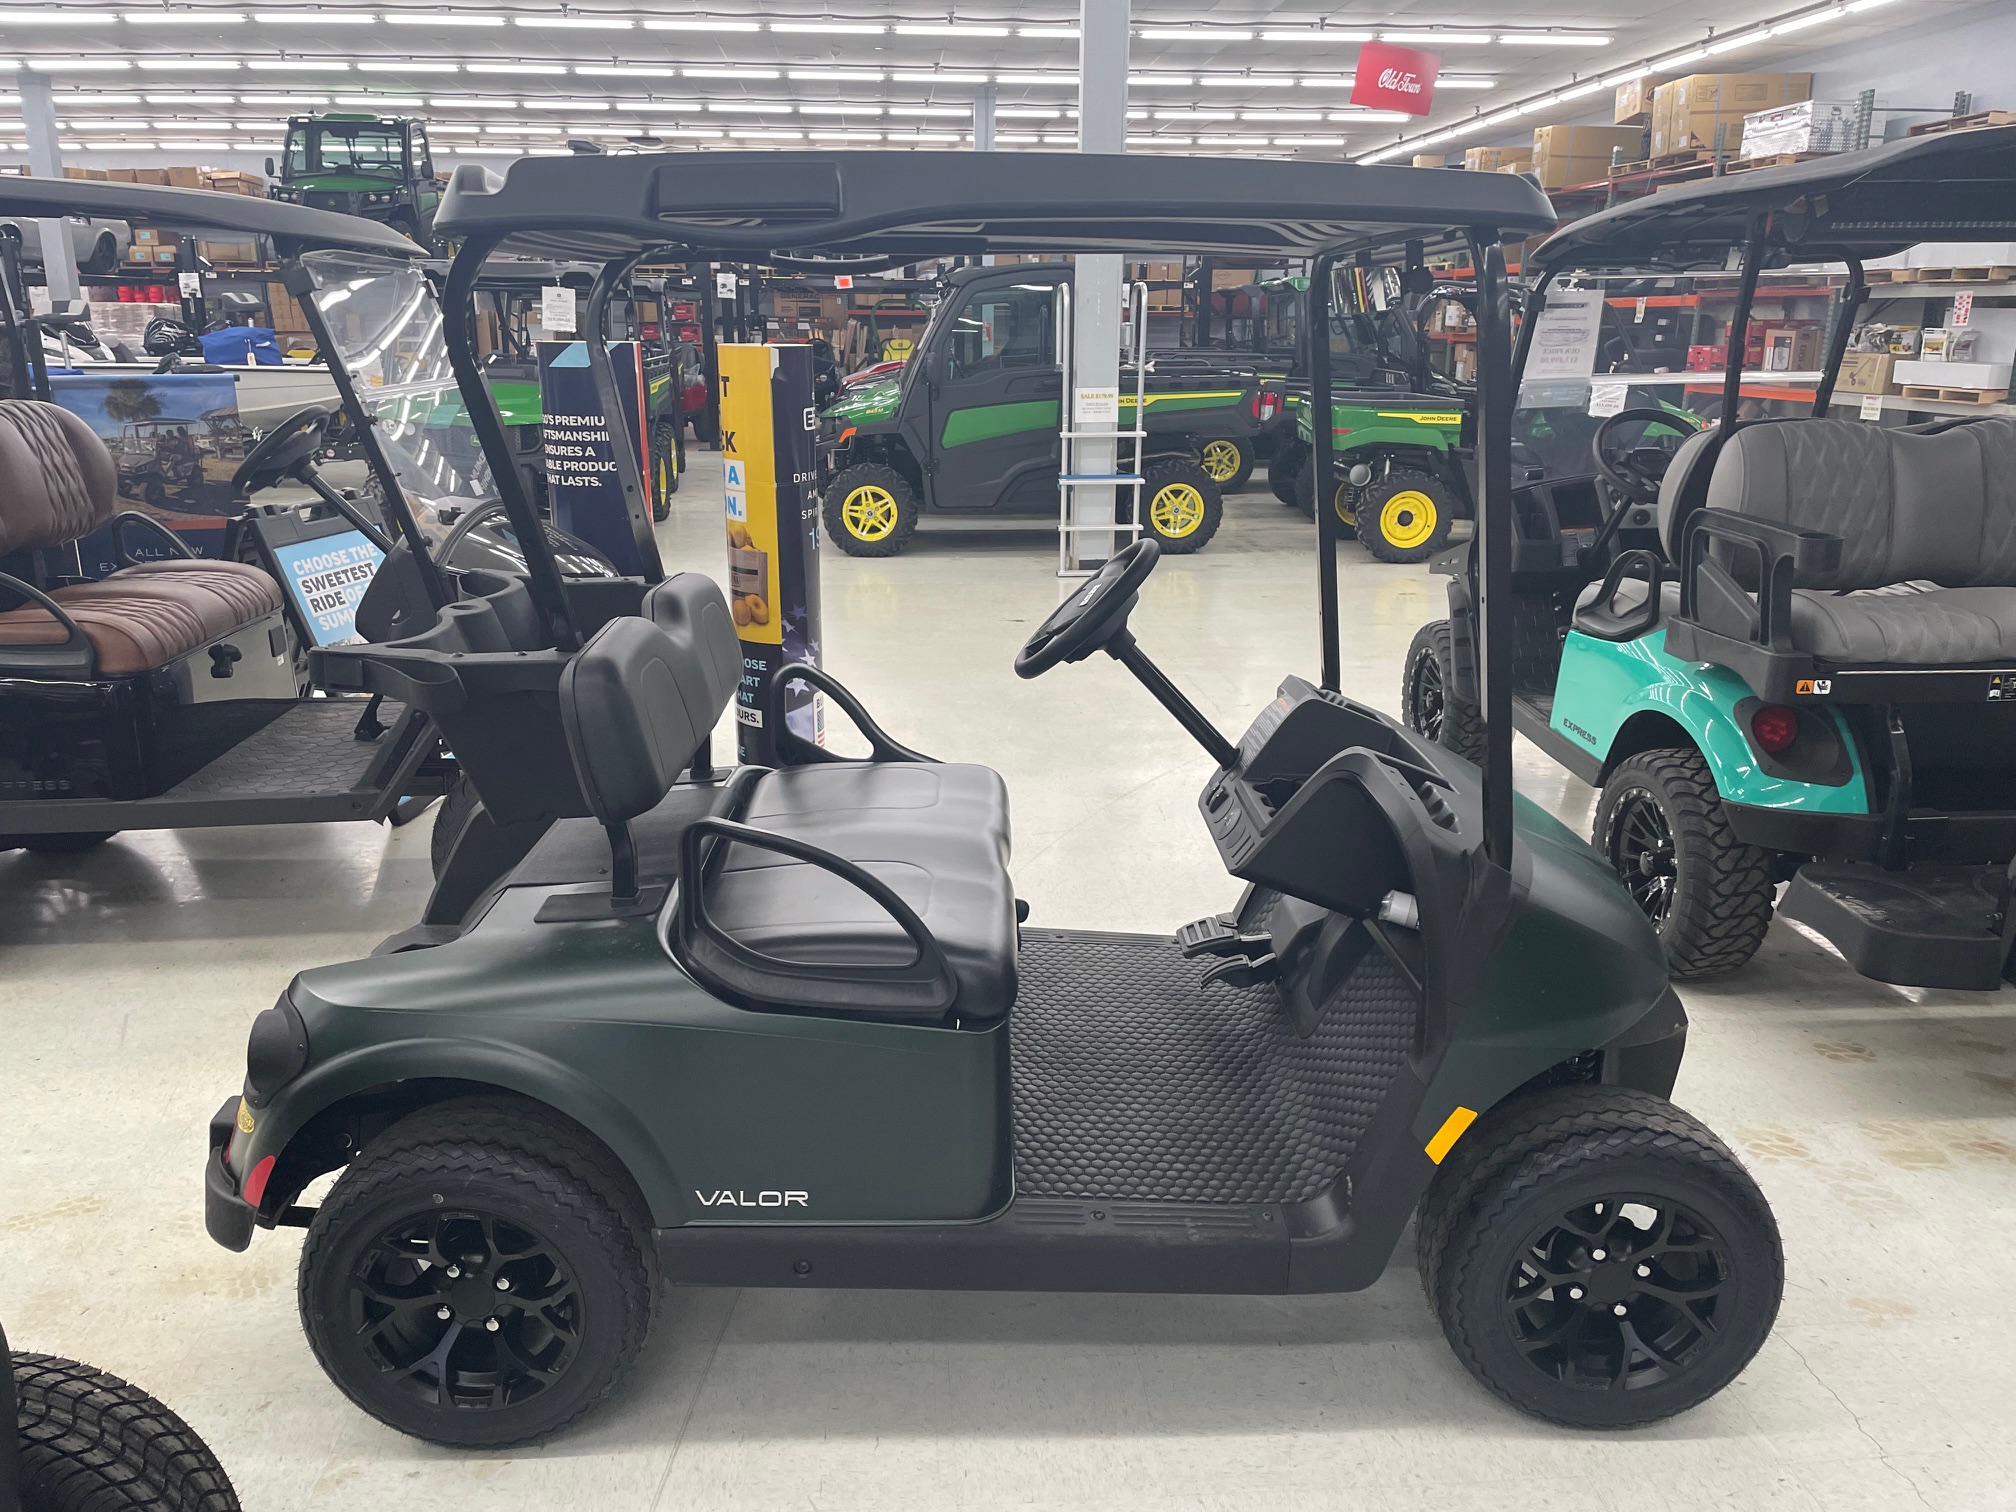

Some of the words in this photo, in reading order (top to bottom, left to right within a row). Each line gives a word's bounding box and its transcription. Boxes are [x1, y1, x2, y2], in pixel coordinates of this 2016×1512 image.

[1377, 67, 1403, 91] Old
[555, 415, 606, 426] PREMIU
[585, 446, 596, 457] A
[563, 461, 617, 472] PRODUC
[561, 476, 602, 487] LASTS.
[135, 548, 164, 557] ALL
[169, 546, 203, 556] NW
[293, 549, 350, 575] CHOOSE
[348, 543, 378, 561] THE
[301, 562, 374, 594] SWEETEST
[309, 590, 346, 613] RIDE
[318, 608, 356, 631] SUM
[744, 658, 767, 671] OSE
[740, 675, 760, 688] ART
[1563, 717, 1597, 745] EXPRESS
[695, 1190, 809, 1207] VALOR
